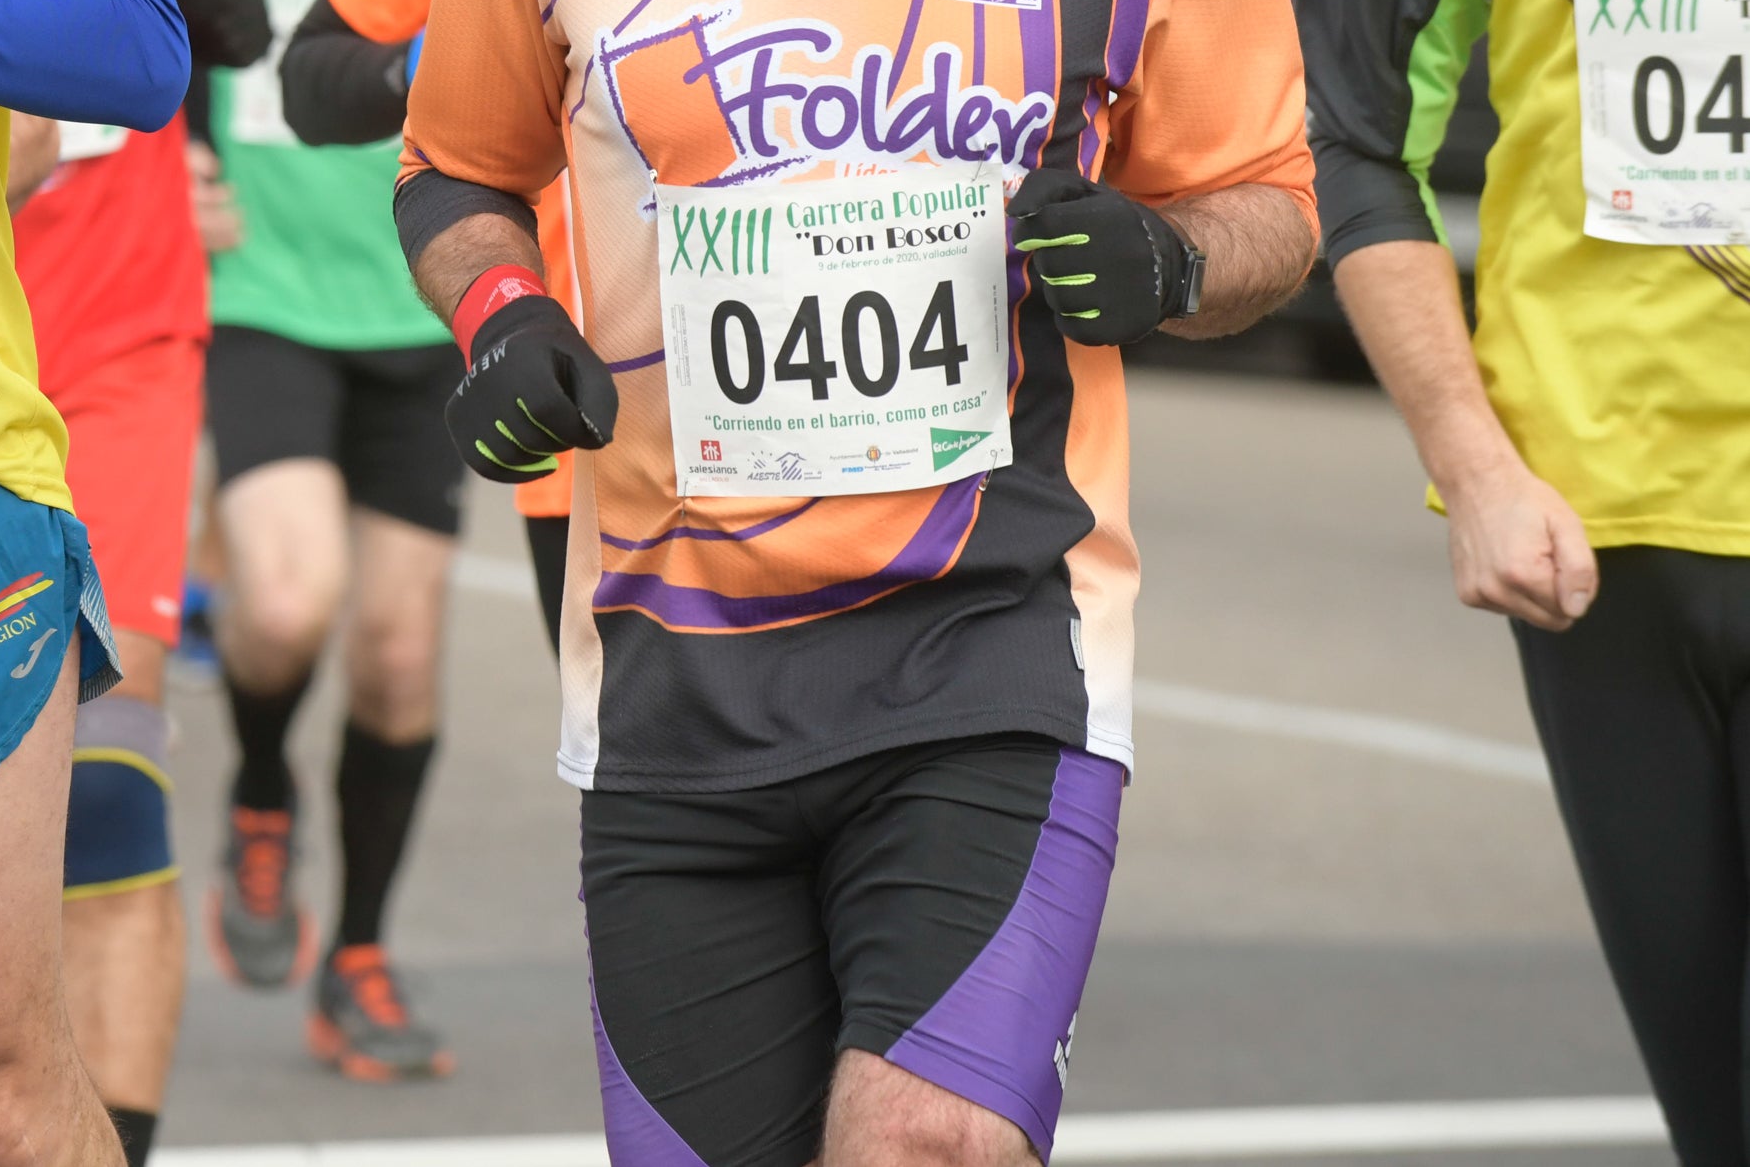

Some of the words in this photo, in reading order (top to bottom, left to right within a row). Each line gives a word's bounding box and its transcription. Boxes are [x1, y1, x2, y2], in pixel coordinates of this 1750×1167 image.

[683, 28, 1047, 163] Folder
[1702, 169, 1719, 180] en
[787, 200, 884, 229] Carrera
[892, 183, 991, 220] Popular
[671, 204, 772, 278] XXIII
[818, 261, 825, 271] 9
[827, 259, 839, 271] de
[841, 257, 880, 270] febrero
[882, 252, 894, 265] de
[896, 253, 922, 265] 2020,
[923, 245, 968, 261] Valladolid
[710, 280, 969, 404] 0404
[788, 418, 804, 430] en
[810, 414, 824, 429] el
[829, 410, 880, 428] barrio,
[886, 406, 926, 423] como
[931, 403, 949, 417] en
[689, 464, 738, 475] salesianos
